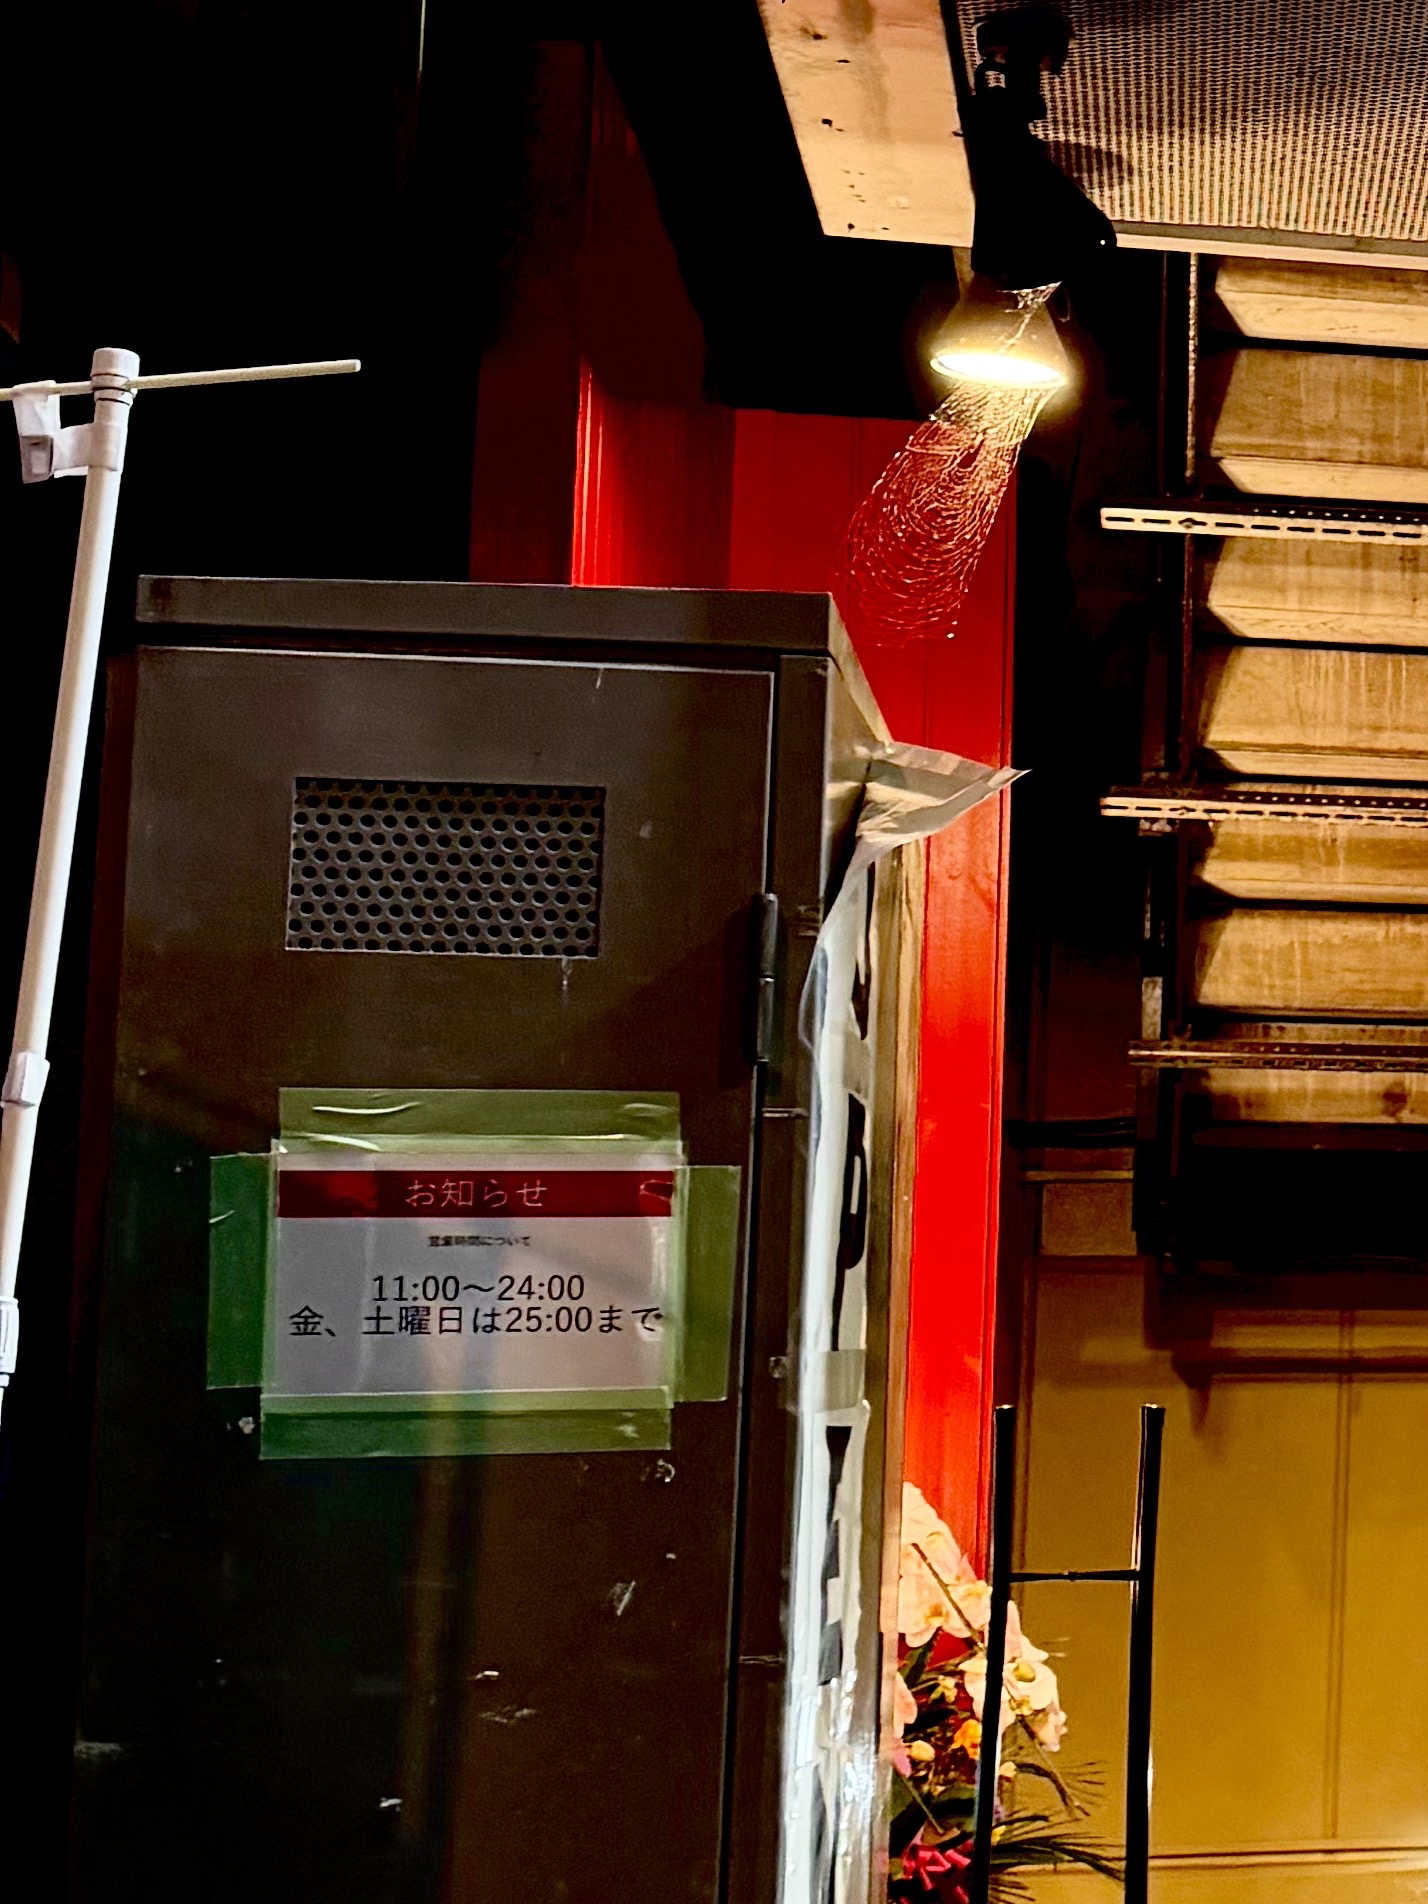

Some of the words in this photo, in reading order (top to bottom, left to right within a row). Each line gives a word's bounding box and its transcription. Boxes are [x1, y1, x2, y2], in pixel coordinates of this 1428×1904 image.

[404, 1178, 549, 1209] お知らせ
[289, 1305, 664, 1338] 金、土曜日は25:00まで
